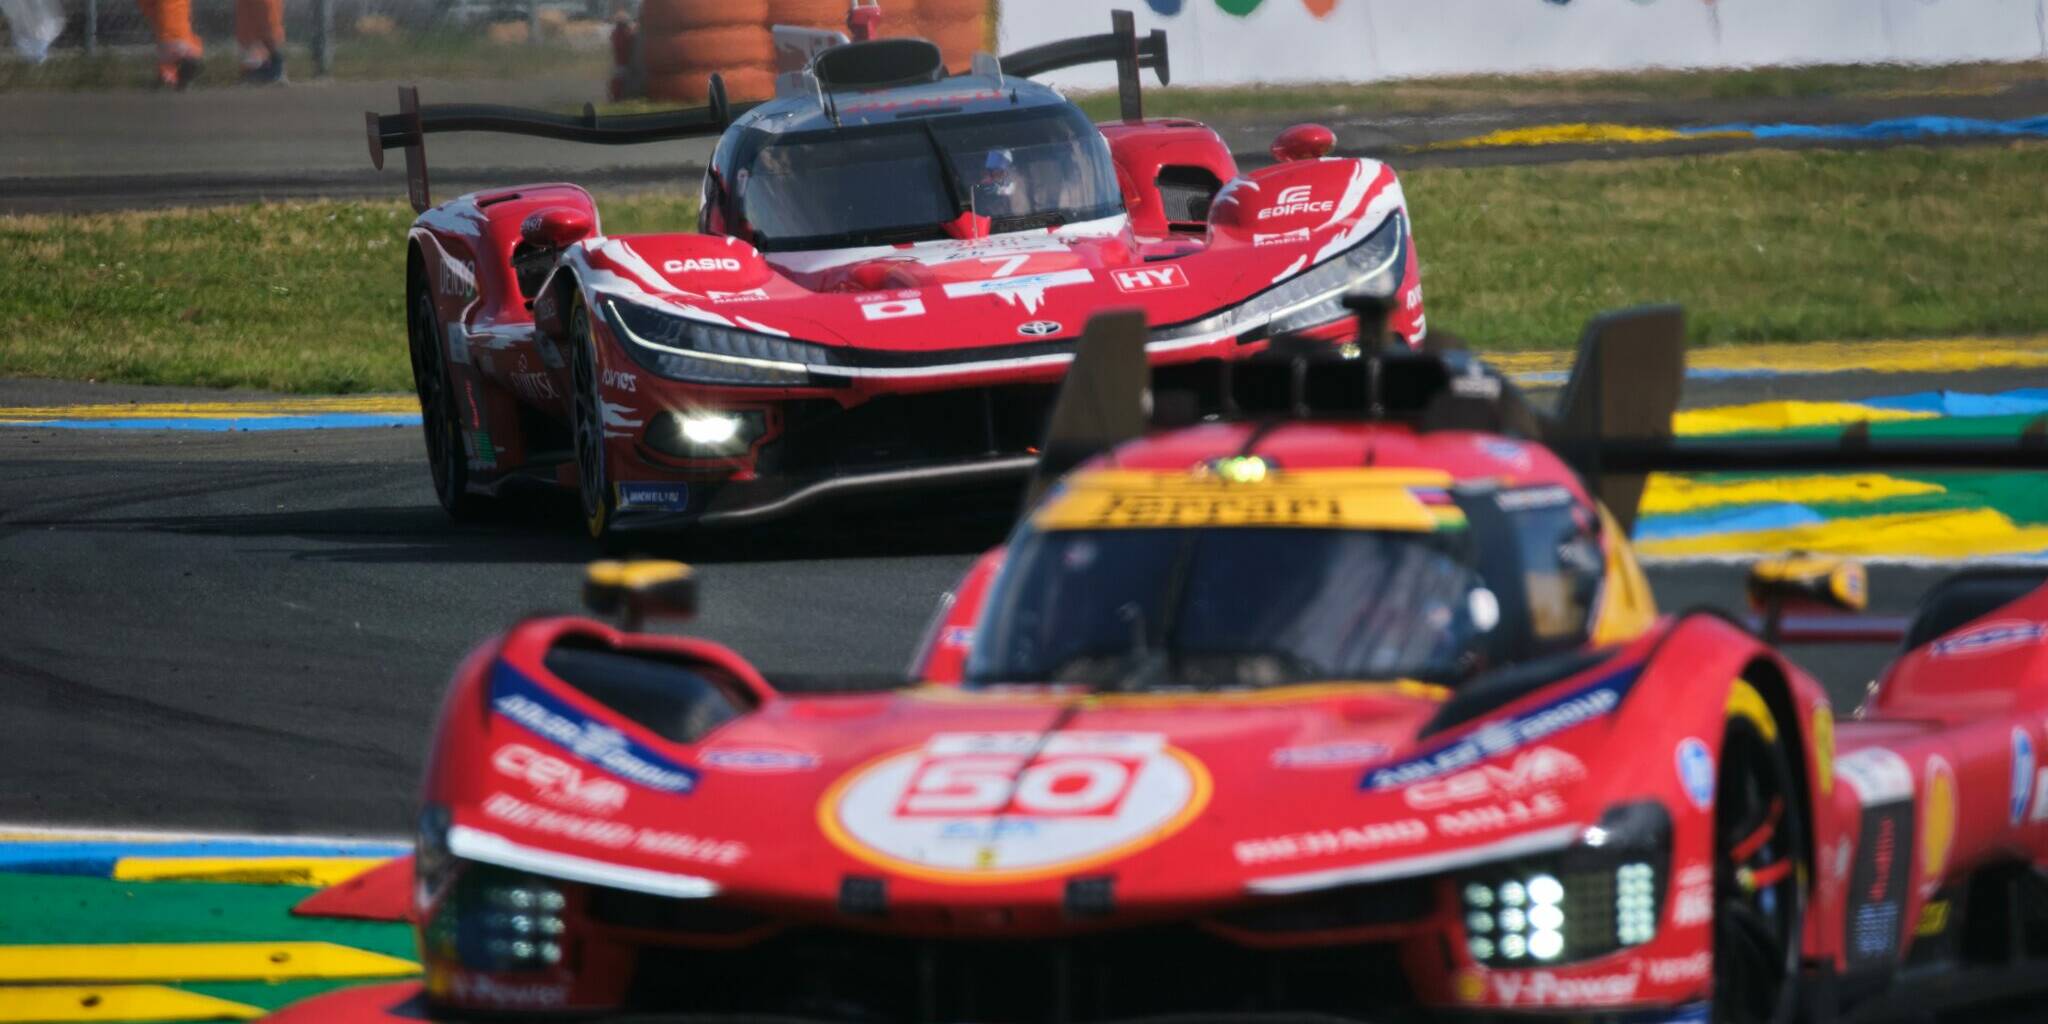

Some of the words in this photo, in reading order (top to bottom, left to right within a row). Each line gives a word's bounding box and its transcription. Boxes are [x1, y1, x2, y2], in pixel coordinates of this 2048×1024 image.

[1257, 200, 1334, 220] EDIFICE
[663, 258, 741, 274] CASIO
[979, 254, 1031, 278] 7
[1117, 267, 1175, 290] HY
[897, 757, 1132, 816] 50
